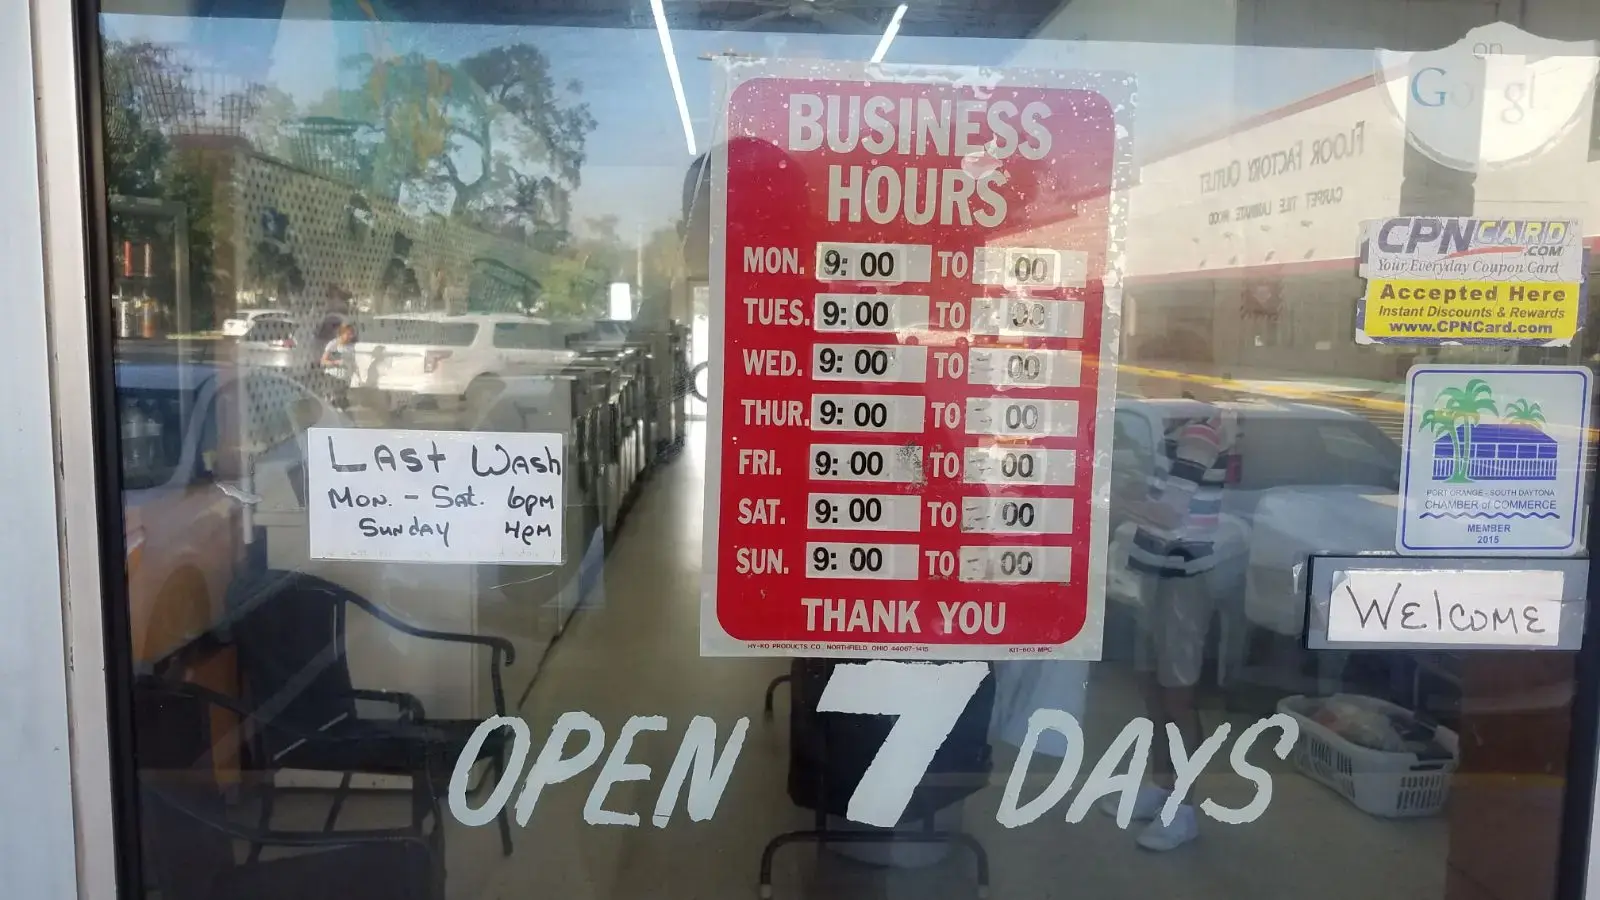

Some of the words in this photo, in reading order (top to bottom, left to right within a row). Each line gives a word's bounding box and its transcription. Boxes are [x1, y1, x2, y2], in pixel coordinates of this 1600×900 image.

[1473, 42, 1503, 59] on
[789, 93, 1053, 161] BUSINESS
[827, 165, 1008, 228] HOURS
[743, 247, 805, 276] MON.
[938, 251, 968, 278] TO
[1378, 259, 1407, 271] Your
[1410, 259, 1469, 275] Everyday
[1472, 261, 1523, 276] Coupon
[1527, 260, 1559, 274] Card
[1380, 284, 1498, 303] Accepted
[1509, 286, 1566, 301] Here
[743, 298, 810, 327] TUES.
[936, 302, 965, 328] TO
[1379, 306, 1424, 317] Instant
[1427, 307, 1492, 318] Discounts
[1497, 307, 1505, 318] &
[1510, 307, 1565, 319] Rewards
[1389, 320, 1552, 334] www.CPNCard.com
[743, 350, 803, 376] WED.
[933, 352, 964, 379] TO
[741, 400, 810, 427] THUR.
[932, 403, 961, 429] TO
[739, 449, 782, 475] FRI.
[930, 452, 960, 478] TO
[737, 498, 786, 525] SAT.
[928, 502, 957, 528] TO
[1425, 500, 1478, 509] CHAMBER
[1482, 501, 1490, 509] of
[1492, 500, 1556, 509] COMMERCE
[1467, 524, 1511, 533] MEMBER
[1477, 536, 1499, 544] 2015
[736, 549, 789, 575] SUN.
[925, 551, 954, 577] TO
[802, 598, 920, 633] THANK
[937, 601, 1006, 635] YOU
[447, 710, 750, 828] OPEN
[815, 660, 991, 828] 7
[995, 708, 1299, 829] DAYS
